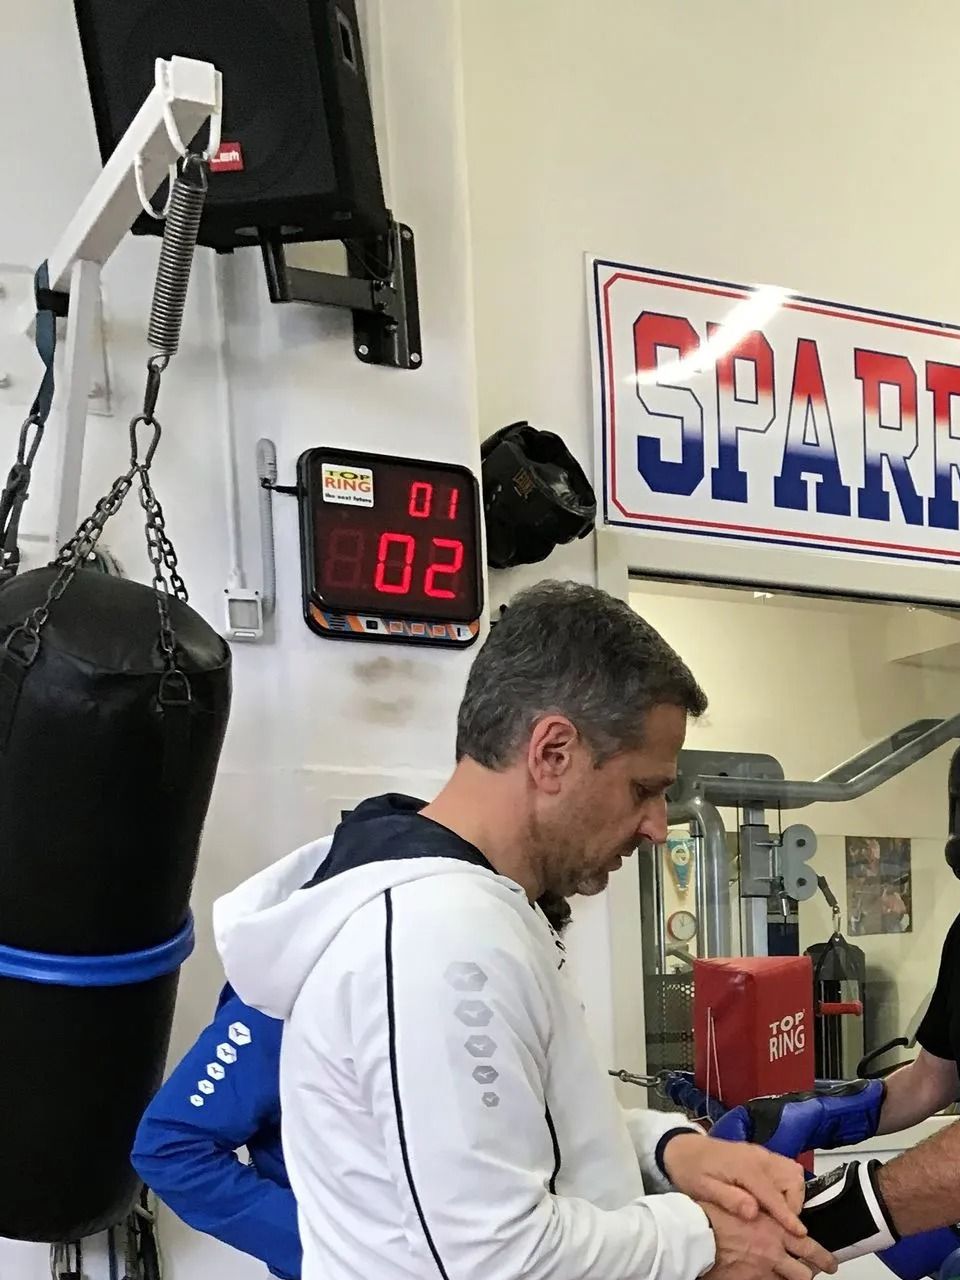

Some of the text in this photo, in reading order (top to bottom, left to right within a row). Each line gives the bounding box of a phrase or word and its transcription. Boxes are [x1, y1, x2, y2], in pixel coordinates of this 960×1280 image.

[325, 469, 371, 481] TOP
[325, 476, 371, 493] RING
[409, 482, 459, 520] 01
[374, 531, 465, 599] 02
[769, 1011, 805, 1035] TOP
[769, 1025, 806, 1062] RING
